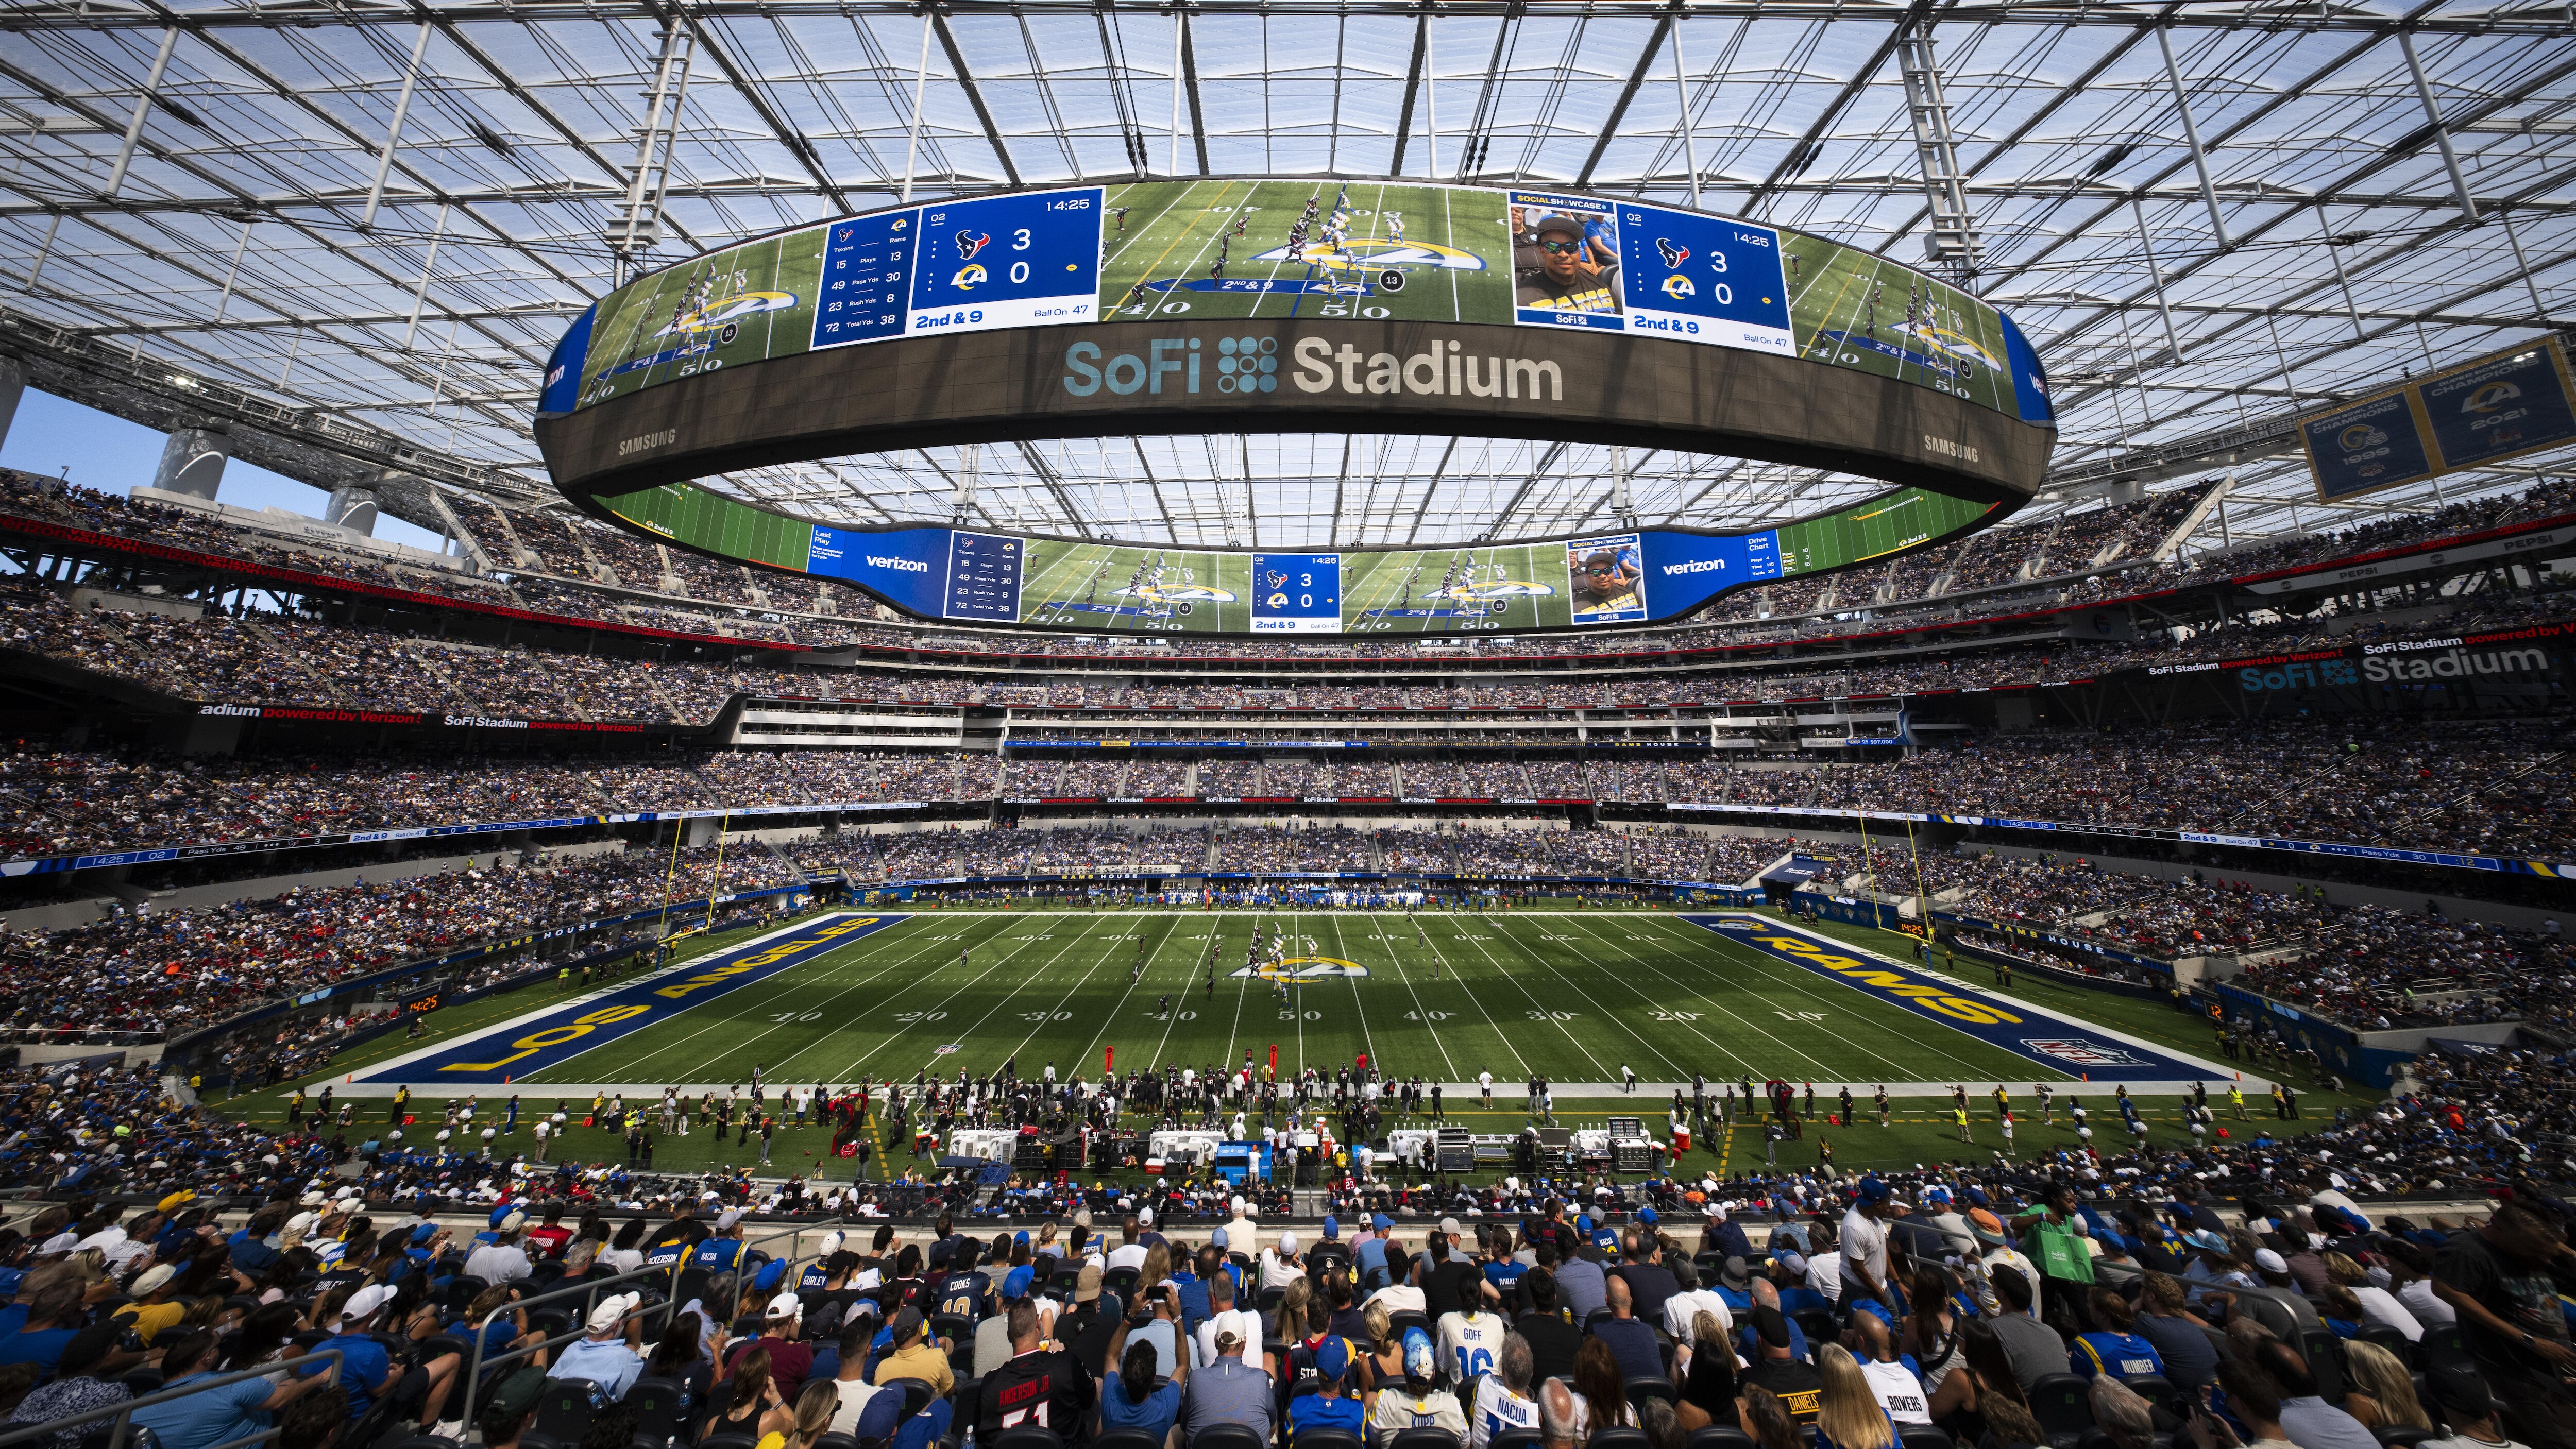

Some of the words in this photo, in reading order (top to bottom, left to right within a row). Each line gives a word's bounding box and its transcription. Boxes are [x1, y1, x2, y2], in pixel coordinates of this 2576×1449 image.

[1047, 199, 1090, 211] 14:25
[931, 213, 945, 222] Q2
[1626, 213, 1641, 222] Q2
[1012, 228, 1030, 250] 3
[1734, 232, 1769, 247] 14:25
[837, 260, 846, 269] 15
[891, 251, 901, 261] 13
[1710, 251, 1727, 272] 3
[1010, 261, 1030, 283] 0
[1386, 276, 1398, 285] 13
[831, 281, 845, 290] 49
[886, 272, 900, 282] 30
[1715, 283, 1732, 305] 0
[828, 302, 842, 312] 23
[887, 294, 894, 302] 8
[1035, 309, 1052, 317] Ball
[1072, 305, 1088, 314] 47
[826, 322, 839, 333] 72
[880, 315, 895, 325] 38
[916, 314, 950, 329] 2nd
[954, 312, 965, 325] &
[970, 310, 983, 322] 9
[1556, 314, 1577, 324] SoFi
[1063, 337, 1200, 397] SoFi
[1293, 337, 1563, 401] Stadium
[2313, 403, 2399, 434] CHAMPIONS
[619, 428, 675, 456] SAMSUNG
[1925, 435, 1978, 463] SAMSUNG
[2343, 447, 2390, 465] 1999
[815, 530, 831, 538] Last
[815, 537, 829, 545] Play
[2504, 534, 2554, 550] PEPSI
[1749, 543, 1769, 551] Chart
[866, 555, 928, 572] verizon
[1663, 558, 1725, 575] verizon
[1301, 573, 1312, 587] 3
[2339, 566, 2379, 579] PEPSI
[1301, 594, 1312, 608] 0
[2149, 664, 2173, 675] SoFi
[2175, 662, 2218, 673] Stadium
[2222, 656, 2270, 669] powered
[2273, 655, 2286, 665] by
[2288, 650, 2336, 662] Verizon
[2241, 663, 2317, 692] SoFi
[2362, 647, 2548, 683] Stadium
[198, 704, 260, 717] adium
[263, 708, 336, 720] powered
[338, 710, 358, 723] by
[360, 711, 414, 723] Verizon
[353, 833, 371, 842] 2nd
[93, 856, 124, 865] 14:25
[2383, 850, 2400, 859] Yds
[484, 935, 533, 953] RAMS
[544, 921, 598, 939] HOUSE
[1901, 923, 1923, 935] 14:25
[1993, 923, 2038, 939] RAMS
[2048, 934, 2105, 954] HOUSE
[653, 917, 880, 999] ANGELES
[1751, 937, 2023, 1024] RAMS
[409, 995, 437, 1013] 14:25
[2211, 1005, 2222, 1020] 12
[436, 1005, 652, 1071] LOS
[2035, 1041, 2110, 1063] NFL
[1346, 1181, 1354, 1189] 23
[785, 1191, 792, 1200] 10
[1599, 1237, 1614, 1246] NACUA
[701, 1253, 717, 1261] NACUA
[802, 1276, 826, 1286] GURLEY
[950, 1278, 970, 1291] COOKS
[1464, 1328, 1481, 1341] GOFF
[2121, 1359, 2155, 1374] NUMBER
[999, 1379, 1037, 1407] ANDERSON
[1040, 1375, 1049, 1392] JR
[1790, 1394, 1819, 1411] DANIELS
[1887, 1395, 1922, 1412] BOWERS
[1498, 1398, 1527, 1425] NACUA
[1412, 1415, 1435, 1428] KUPP
